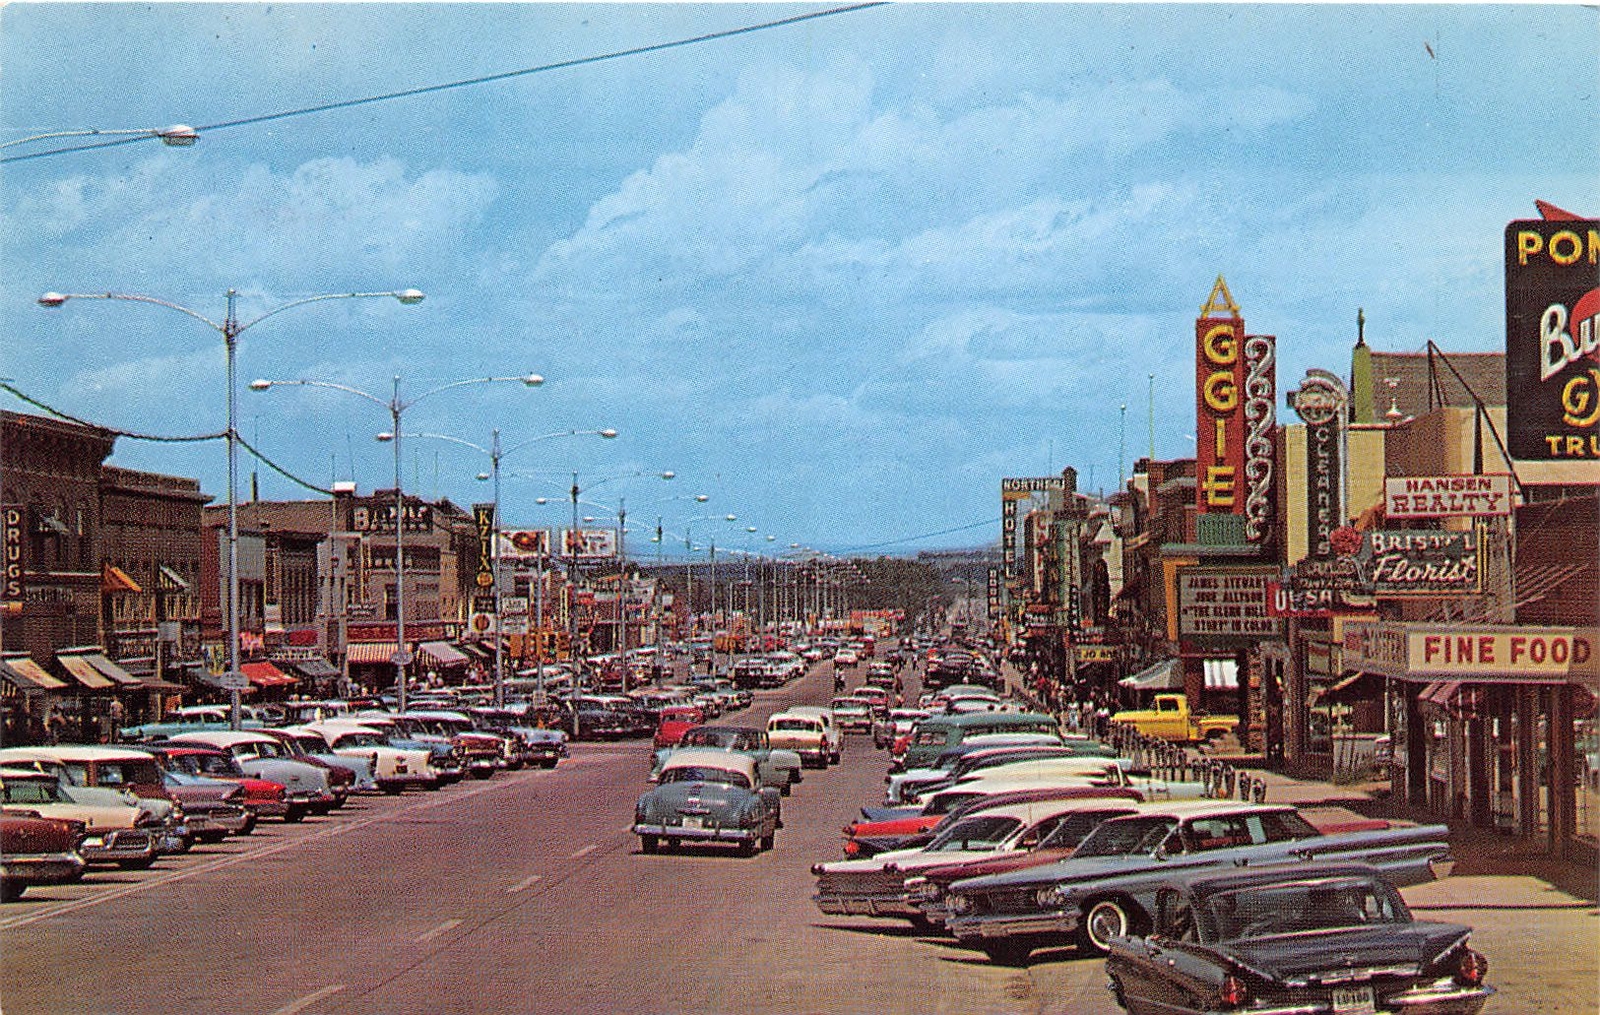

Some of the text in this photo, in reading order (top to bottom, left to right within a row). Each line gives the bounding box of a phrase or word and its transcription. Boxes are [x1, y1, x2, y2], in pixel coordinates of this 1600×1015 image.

[1200, 273, 1240, 506] AGGIE
[1316, 428, 1330, 555] CLEANERS
[1392, 493, 1503, 512] REALTY
[1406, 478, 1491, 492] HANSEN
[8, 510, 21, 597] DRUGS
[478, 511, 491, 571] KZIX
[1005, 501, 1015, 577] HOTEL
[1188, 577, 1218, 589] JAMES
[1373, 554, 1476, 582] Florist
[1425, 636, 1495, 663] FINE
[1510, 637, 1591, 664] FOOD
